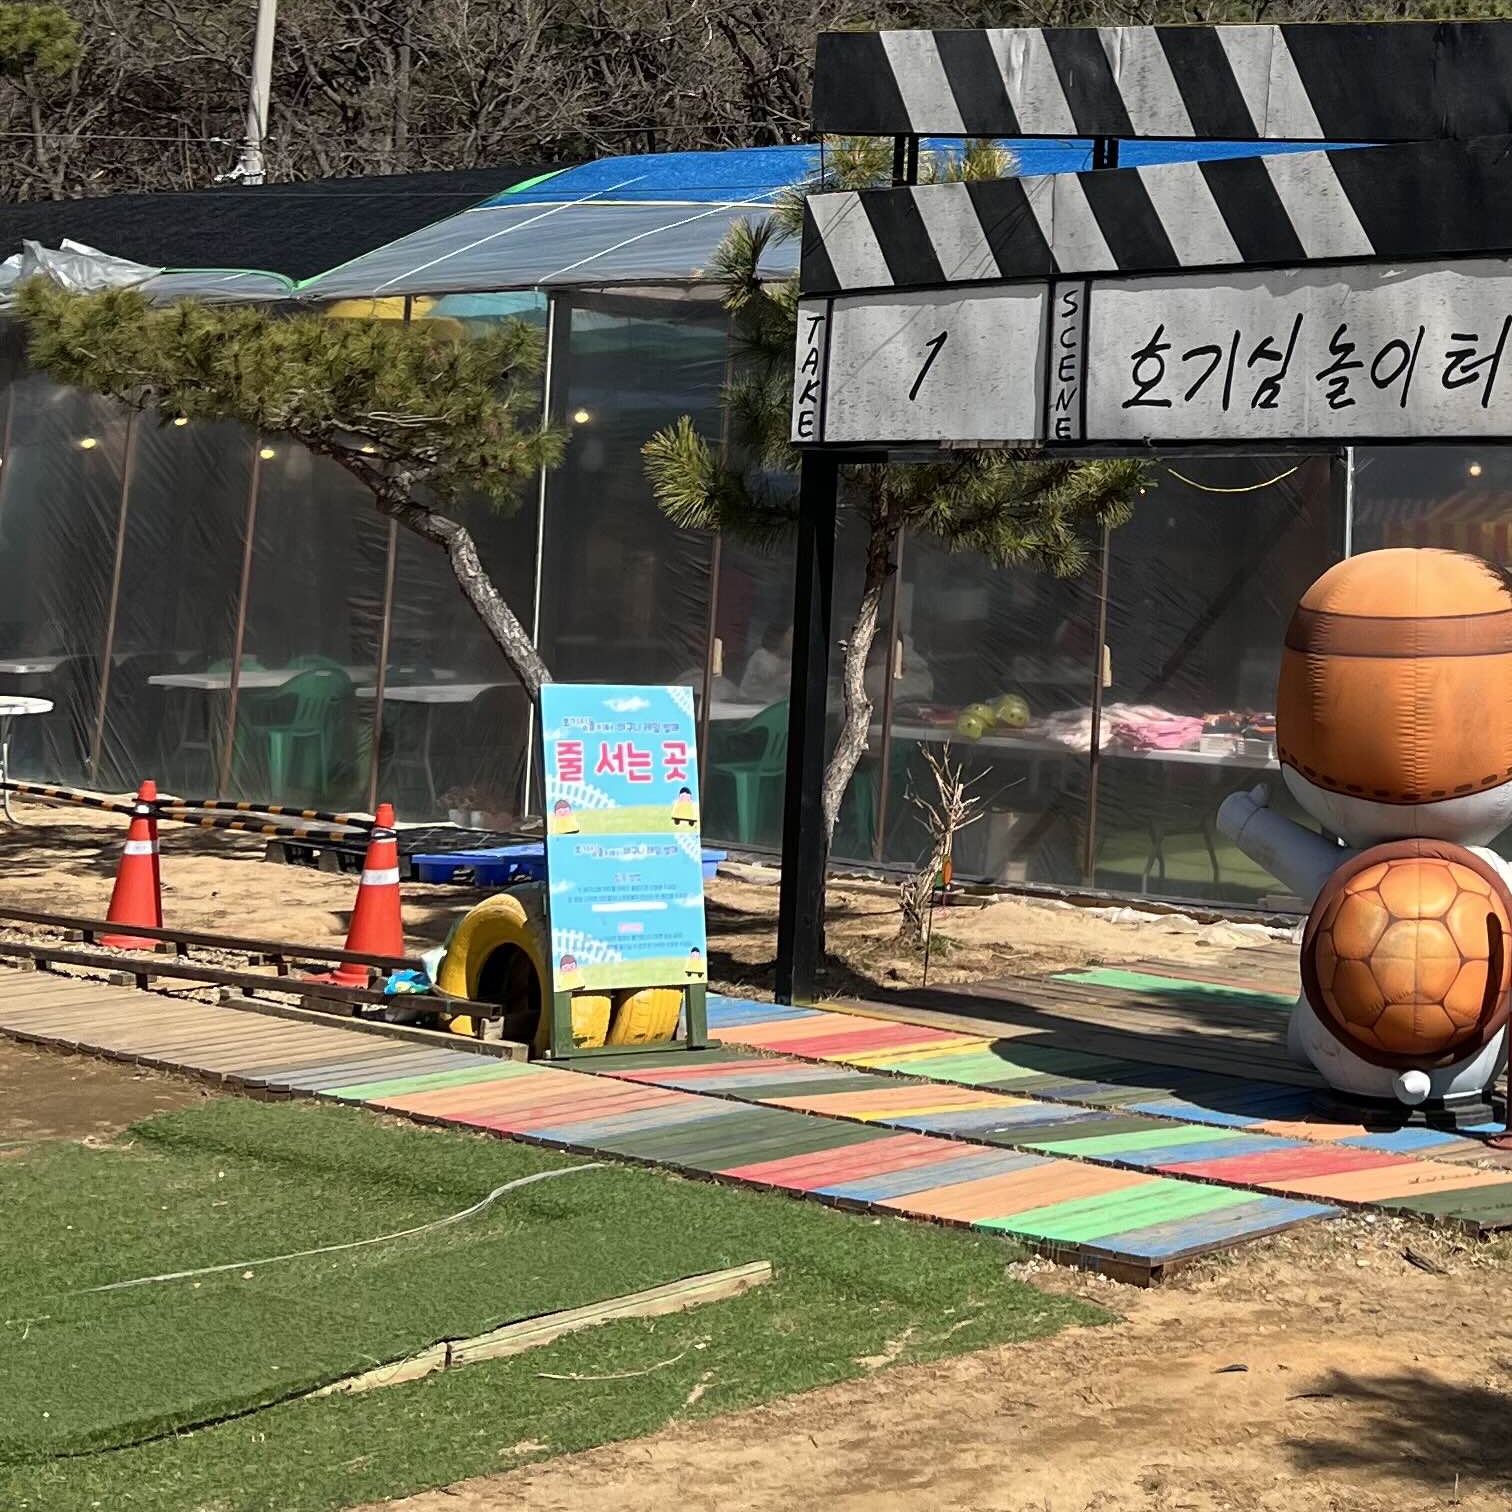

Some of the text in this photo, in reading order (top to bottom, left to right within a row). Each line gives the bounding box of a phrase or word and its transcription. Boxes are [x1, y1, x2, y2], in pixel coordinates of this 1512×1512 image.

[798, 316, 825, 437] TAKE
[909, 331, 948, 401] 1
[1055, 290, 1078, 439] SCENE
[557, 741, 688, 782] 줄 서는 곳
